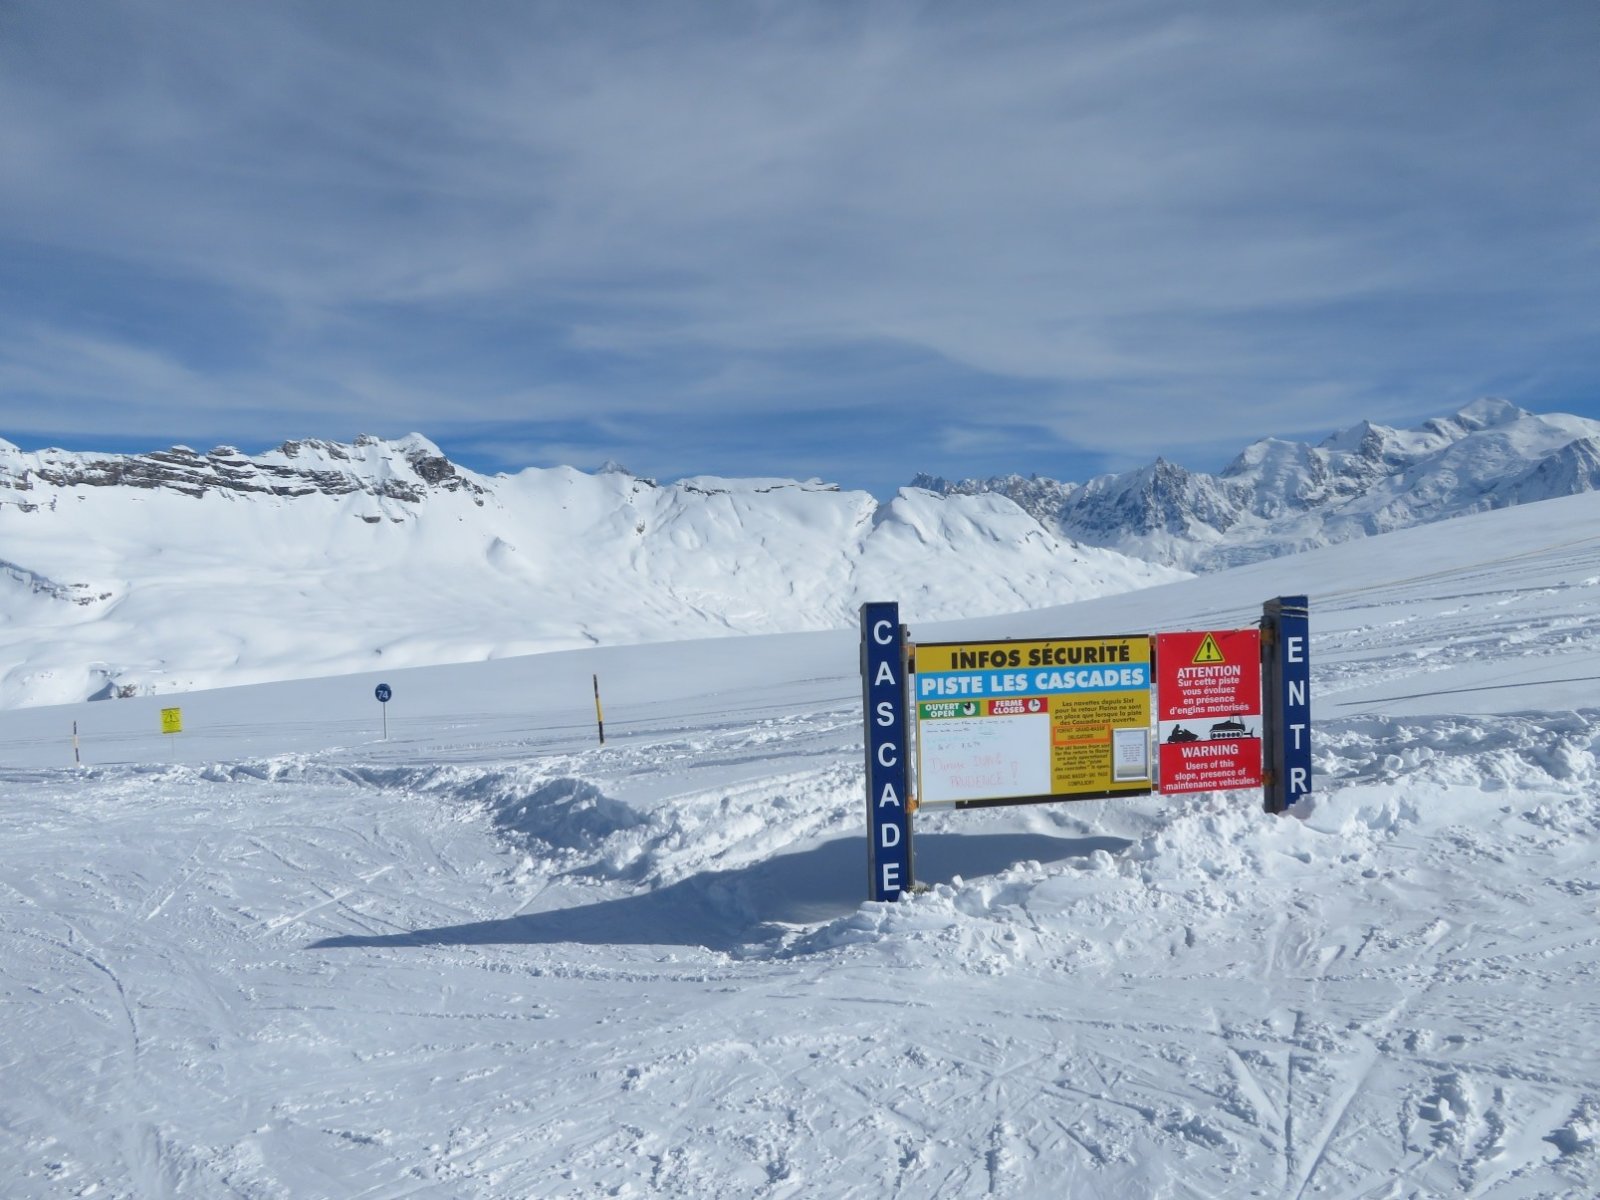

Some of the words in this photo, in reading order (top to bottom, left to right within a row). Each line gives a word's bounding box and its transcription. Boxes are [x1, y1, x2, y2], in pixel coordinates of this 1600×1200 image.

[951, 649, 1021, 669] INFOS
[1028, 641, 1130, 666] SÉCURITÉ
[1177, 665, 1241, 679] ATTENTION
[921, 676, 983, 696] PISTE
[990, 674, 1028, 692] LES
[1035, 668, 1144, 690] CASCADES
[1178, 678, 1192, 687] Sur
[1194, 677, 1216, 686] cette
[1218, 676, 1239, 687] piste
[378, 690, 389, 699] 74
[1182, 688, 1201, 696] vous
[1204, 686, 1236, 695] évoluez
[995, 700, 1023, 708] FERME
[1101, 698, 1121, 706] depuis
[1183, 697, 1194, 705] en
[1196, 694, 1235, 706] présence
[925, 703, 959, 711] OUVERT
[1169, 703, 1206, 715] d'engins
[1207, 702, 1249, 713] motorisés
[1287, 636, 1309, 794] ENTR
[873, 620, 901, 892] CASCADE
[1181, 744, 1239, 758] WARNING
[1186, 761, 1208, 771] Users
[1210, 760, 1219, 769] of
[1219, 759, 1234, 768] this
[1175, 771, 1199, 782] slope,
[1200, 769, 1236, 780] presence
[1238, 767, 1246, 776] of
[1166, 781, 1217, 791] maintenance
[1219, 777, 1256, 787] vehicules
